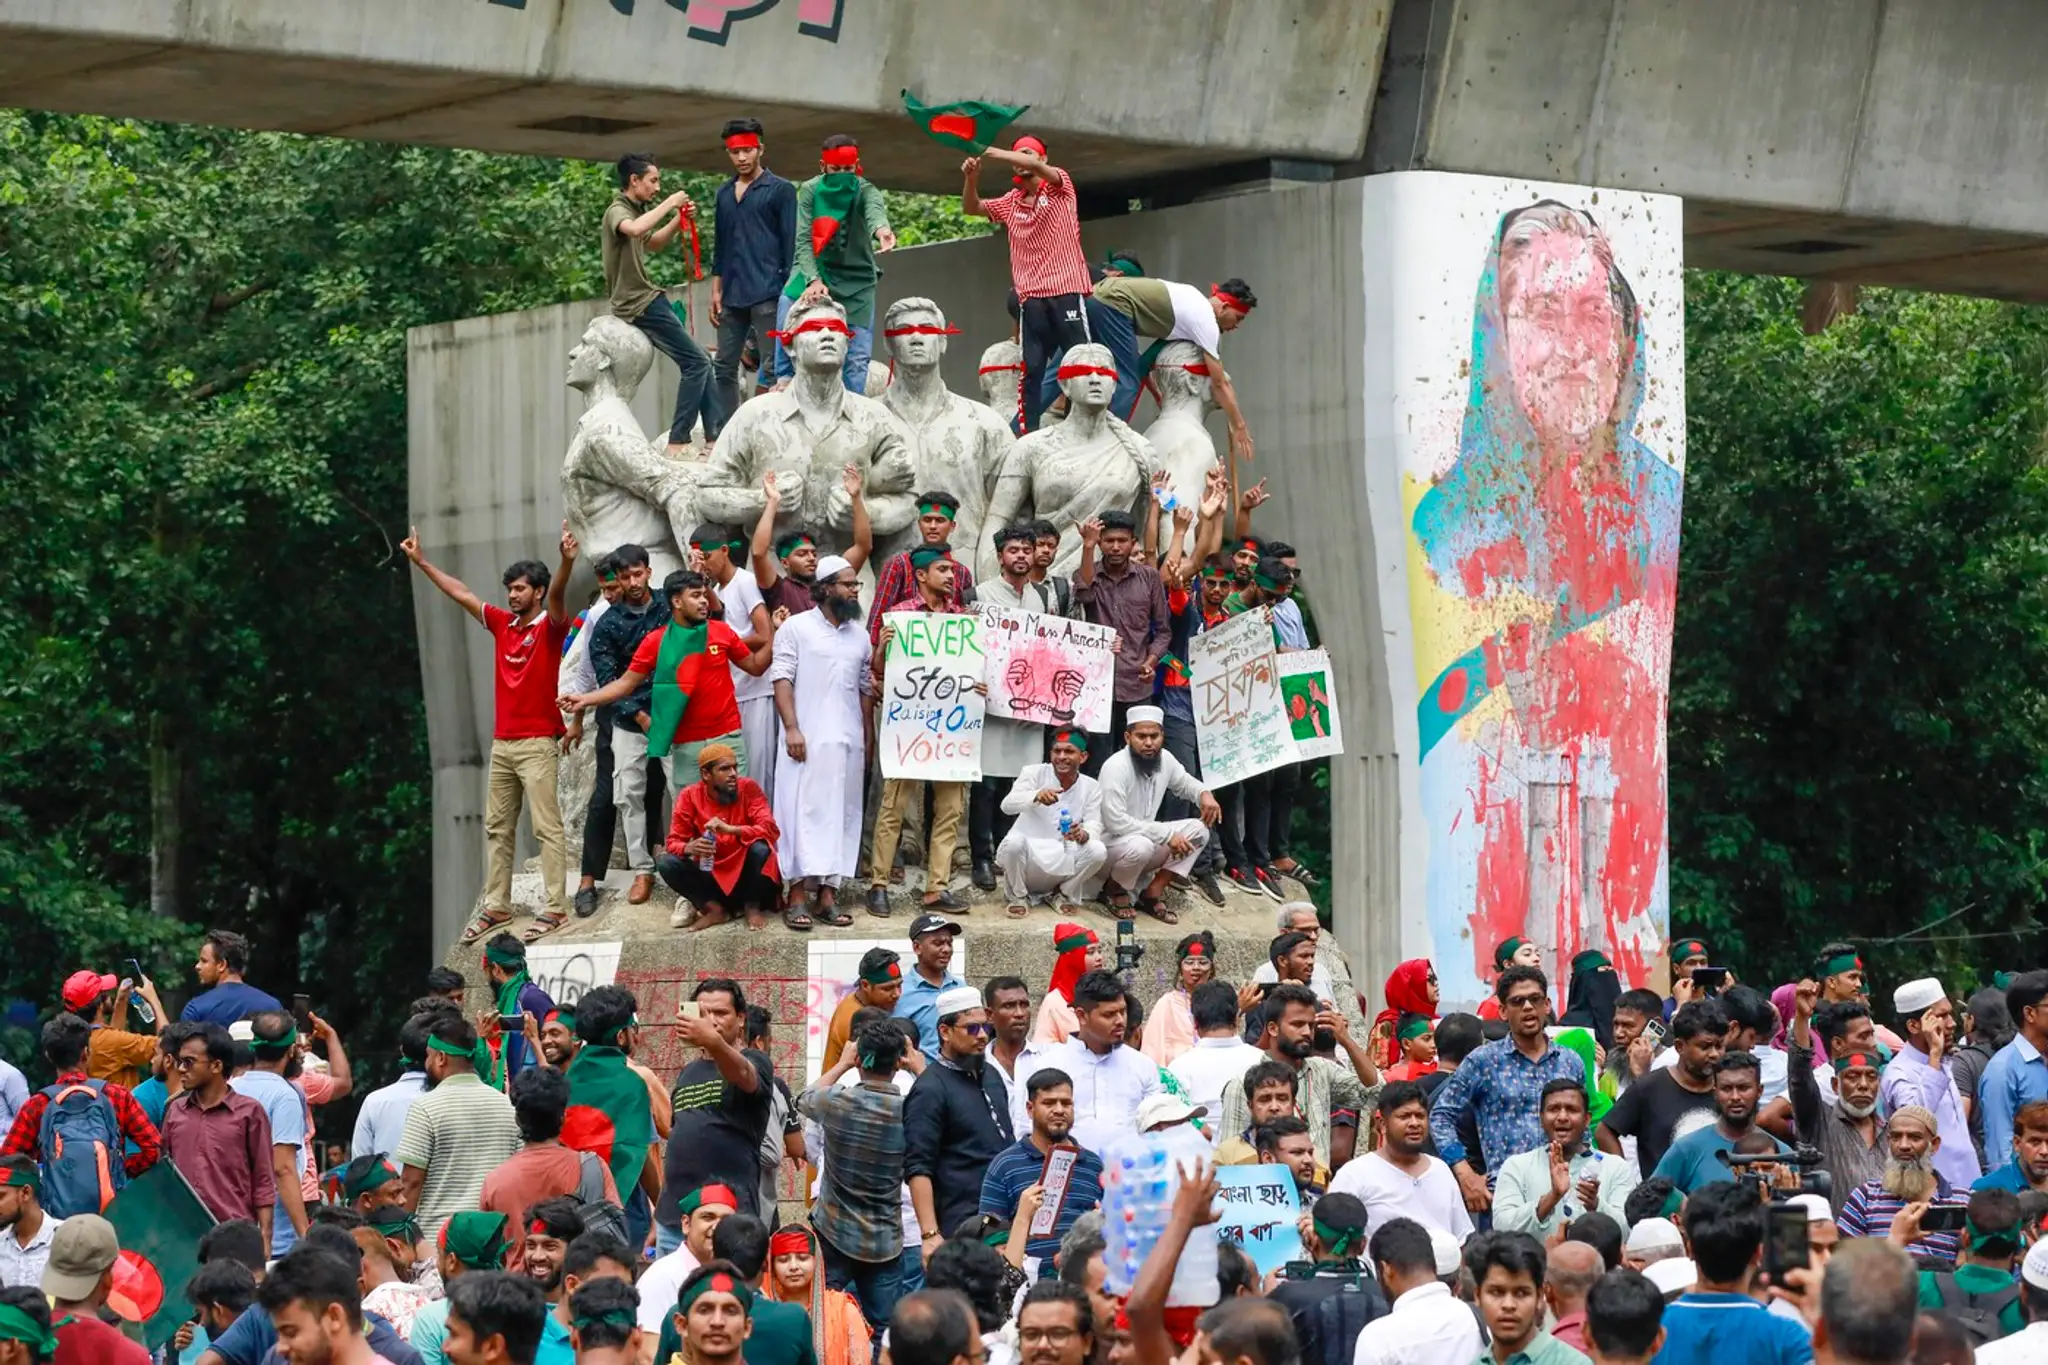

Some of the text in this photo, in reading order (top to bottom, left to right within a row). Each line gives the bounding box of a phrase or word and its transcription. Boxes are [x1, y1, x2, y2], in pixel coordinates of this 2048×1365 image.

[885, 616, 984, 661] NEVER
[1025, 613, 1058, 639] Mass
[1062, 620, 1108, 649] Arrest
[886, 702, 982, 732] Raising Our
[895, 732, 973, 766] Voice
